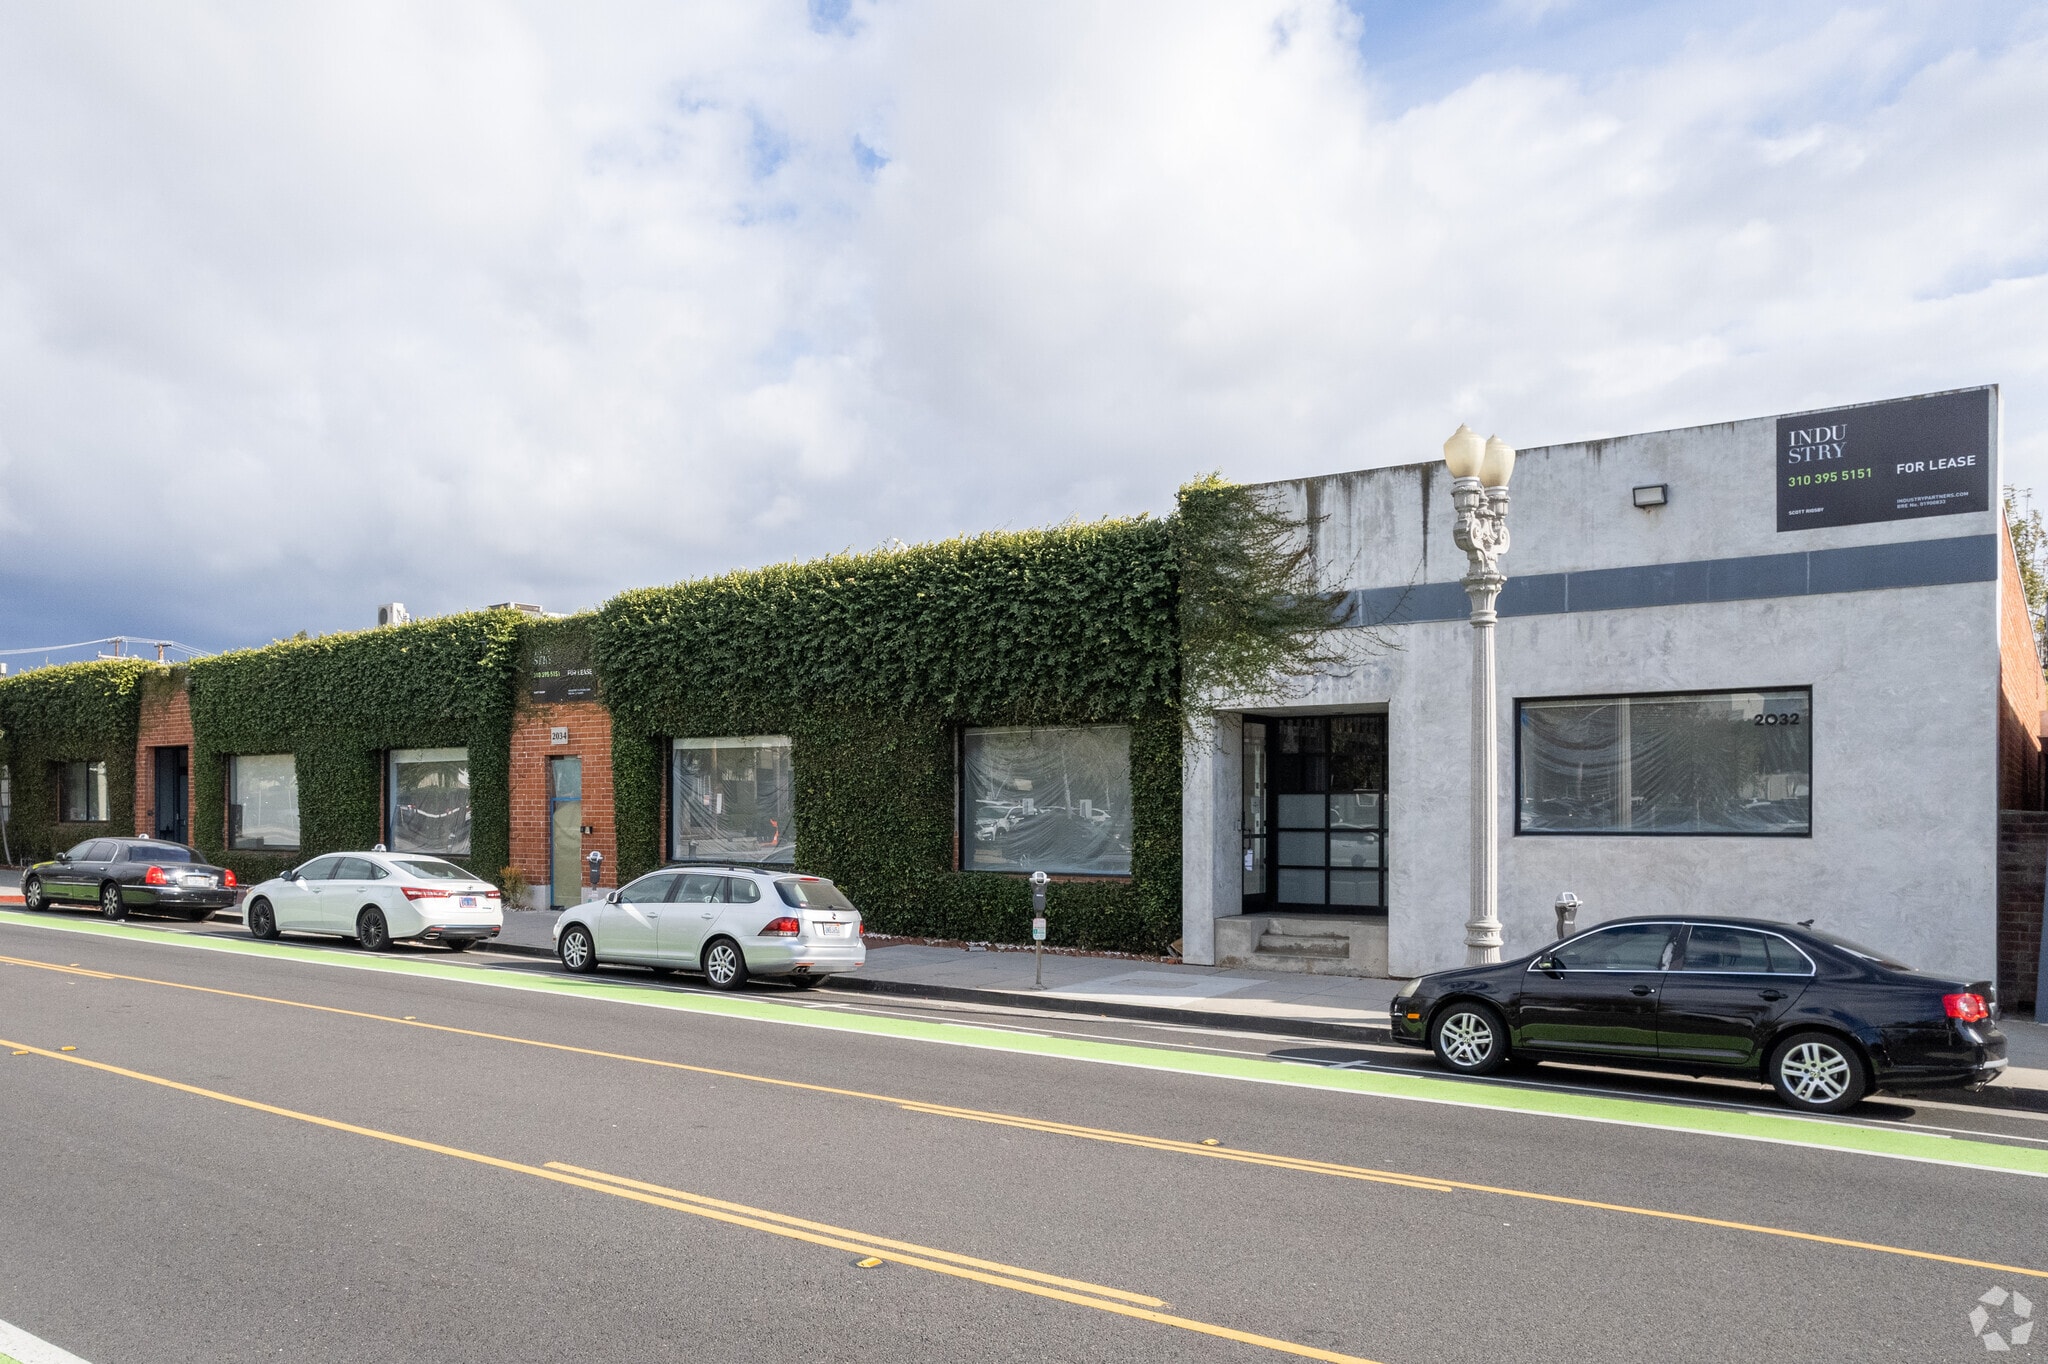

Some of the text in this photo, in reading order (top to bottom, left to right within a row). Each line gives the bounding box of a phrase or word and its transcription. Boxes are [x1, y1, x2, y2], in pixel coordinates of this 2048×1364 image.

[1789, 424, 1847, 446] INDU
[1788, 442, 1847, 464] STRY
[1896, 455, 1976, 474] FOR LEASE
[1788, 468, 1872, 487] 310 395 5151
[1896, 491, 1969, 504] INDUSTRYPARTNERS.COM
[577, 668, 593, 676] LEASE
[1754, 713, 1800, 726] 2032
[552, 731, 567, 740] 2034
